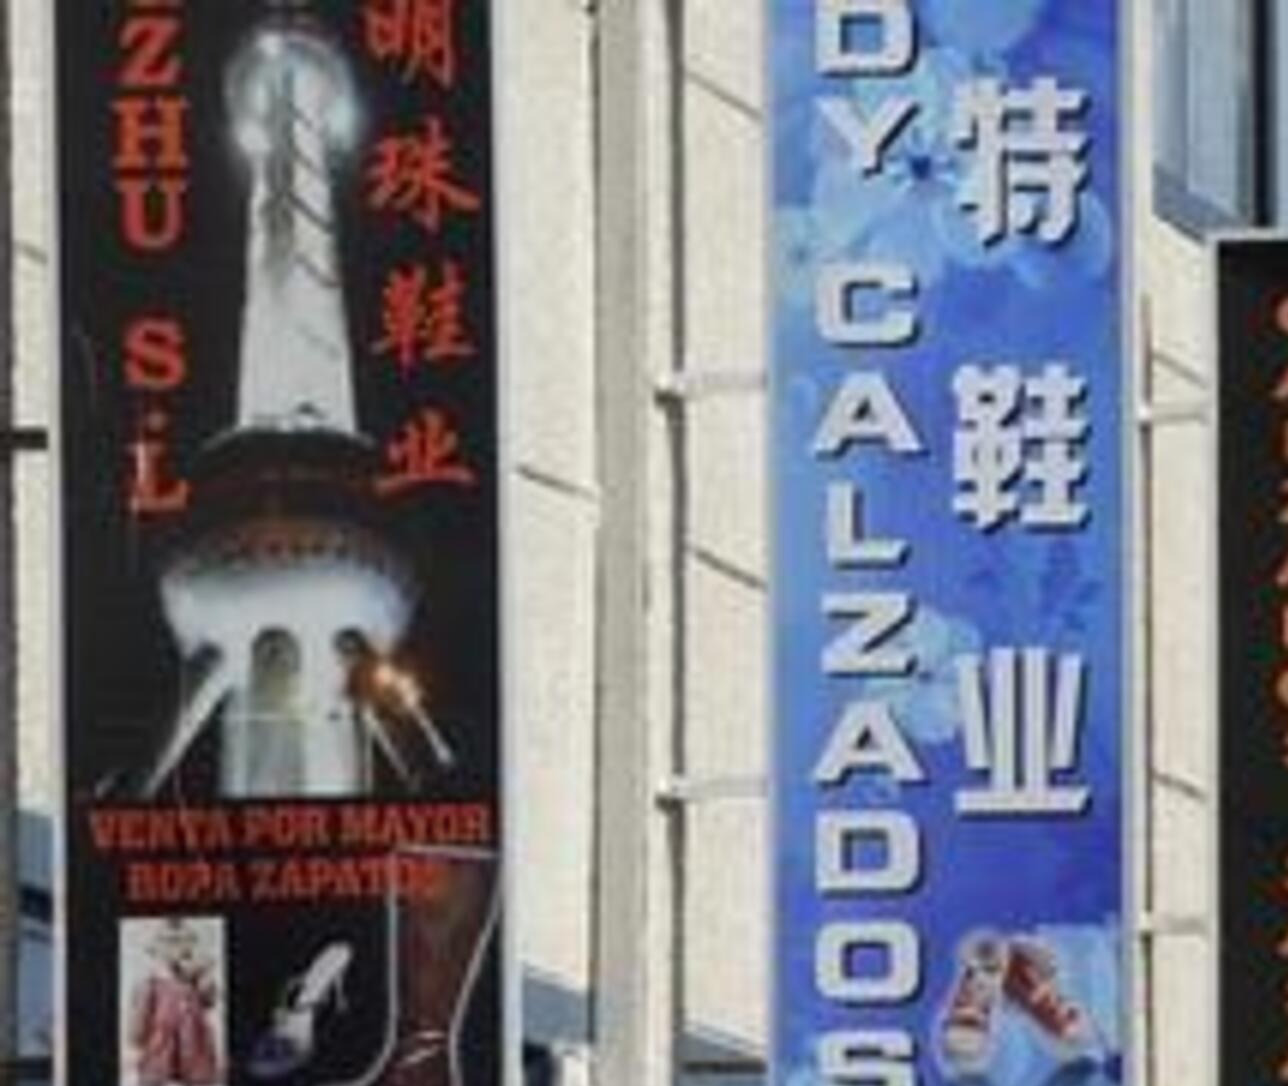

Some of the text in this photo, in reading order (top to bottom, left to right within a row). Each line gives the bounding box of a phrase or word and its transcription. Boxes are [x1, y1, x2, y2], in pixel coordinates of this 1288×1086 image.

[112, 0, 190, 250] ZHU
[813, 0, 922, 178] DY
[951, 75, 1093, 818] 特鞋业
[89, 802, 491, 850] VENTA POR MAYOR
[126, 860, 243, 901] ROPA
